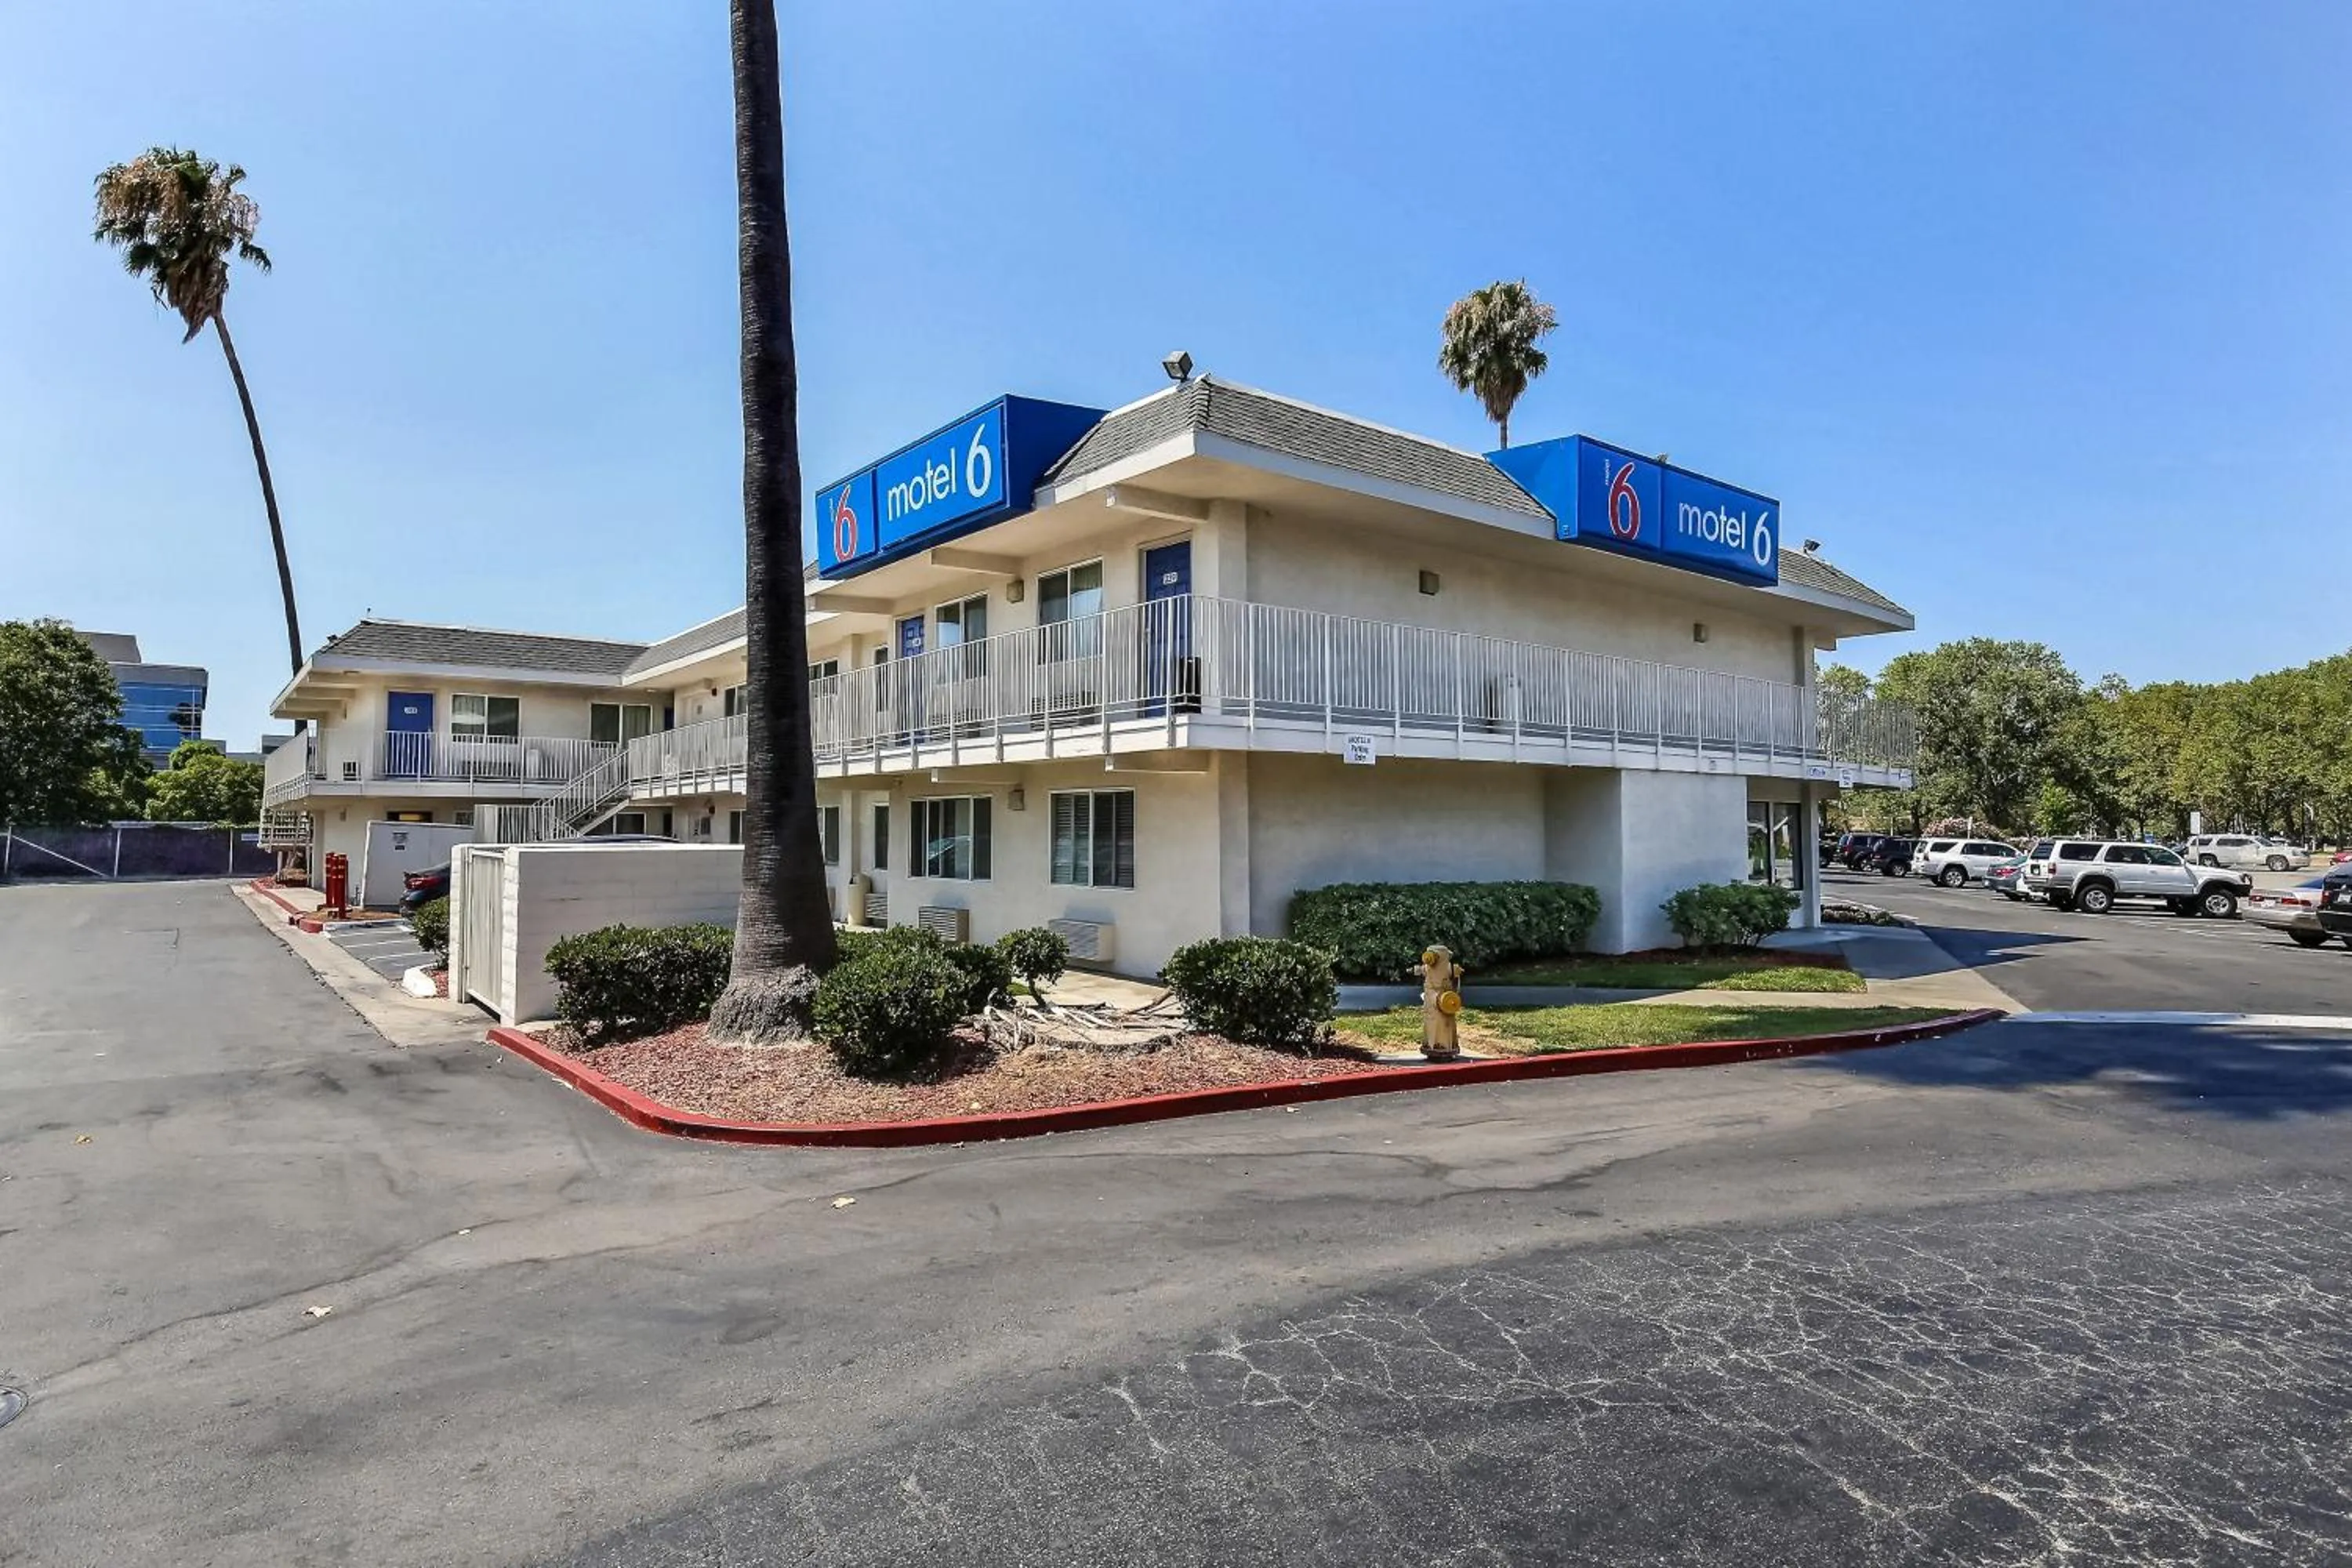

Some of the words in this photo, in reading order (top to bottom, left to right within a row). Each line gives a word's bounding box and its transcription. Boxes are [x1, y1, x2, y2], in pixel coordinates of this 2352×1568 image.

[887, 447, 956, 521] motel
[966, 423, 992, 497] 6
[1609, 462, 1641, 540] 6
[834, 484, 858, 563] 6
[1679, 502, 1746, 550] motel
[1752, 511, 1771, 566] 6
